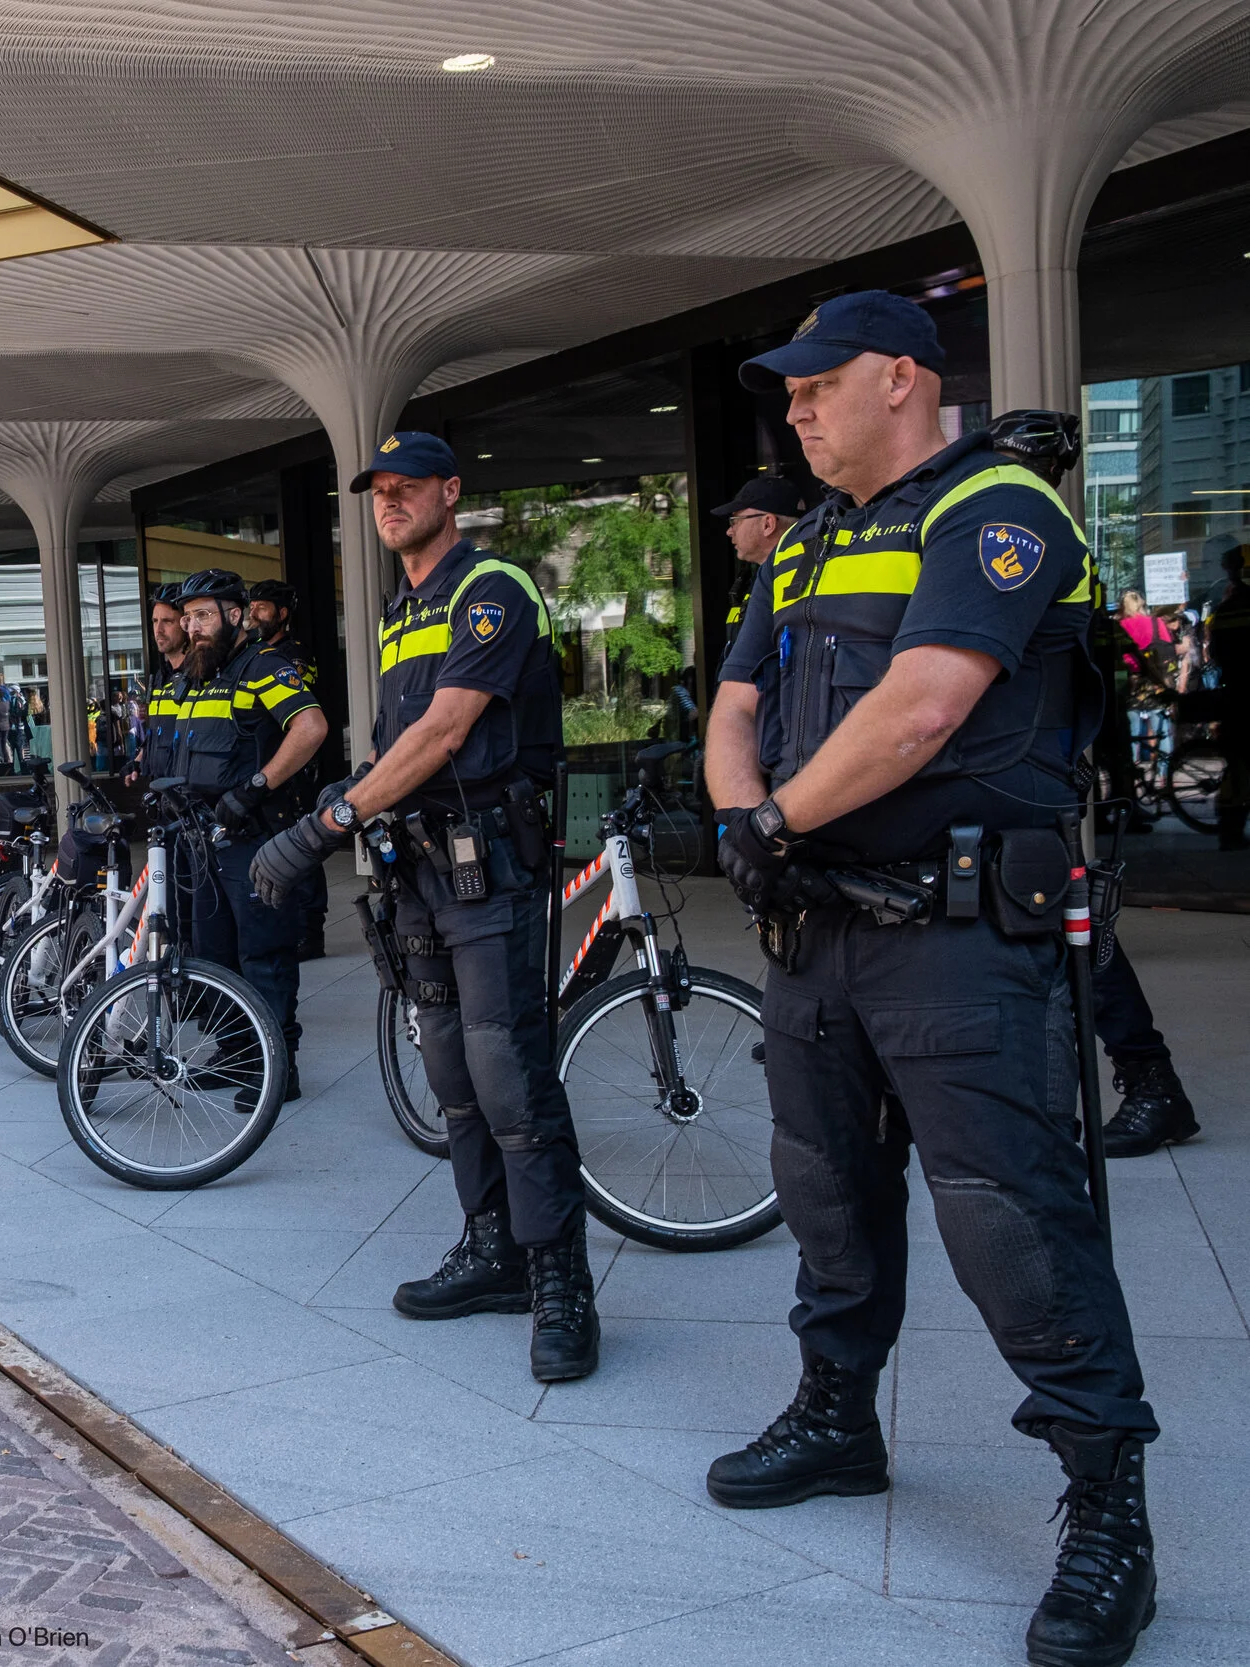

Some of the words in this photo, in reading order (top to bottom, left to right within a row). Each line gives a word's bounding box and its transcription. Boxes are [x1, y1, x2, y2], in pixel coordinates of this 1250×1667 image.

[859, 523, 909, 541] POLITIE
[987, 529, 1040, 553] POLITIE
[471, 606, 502, 616] POLITIE
[616, 840, 631, 859] 21
